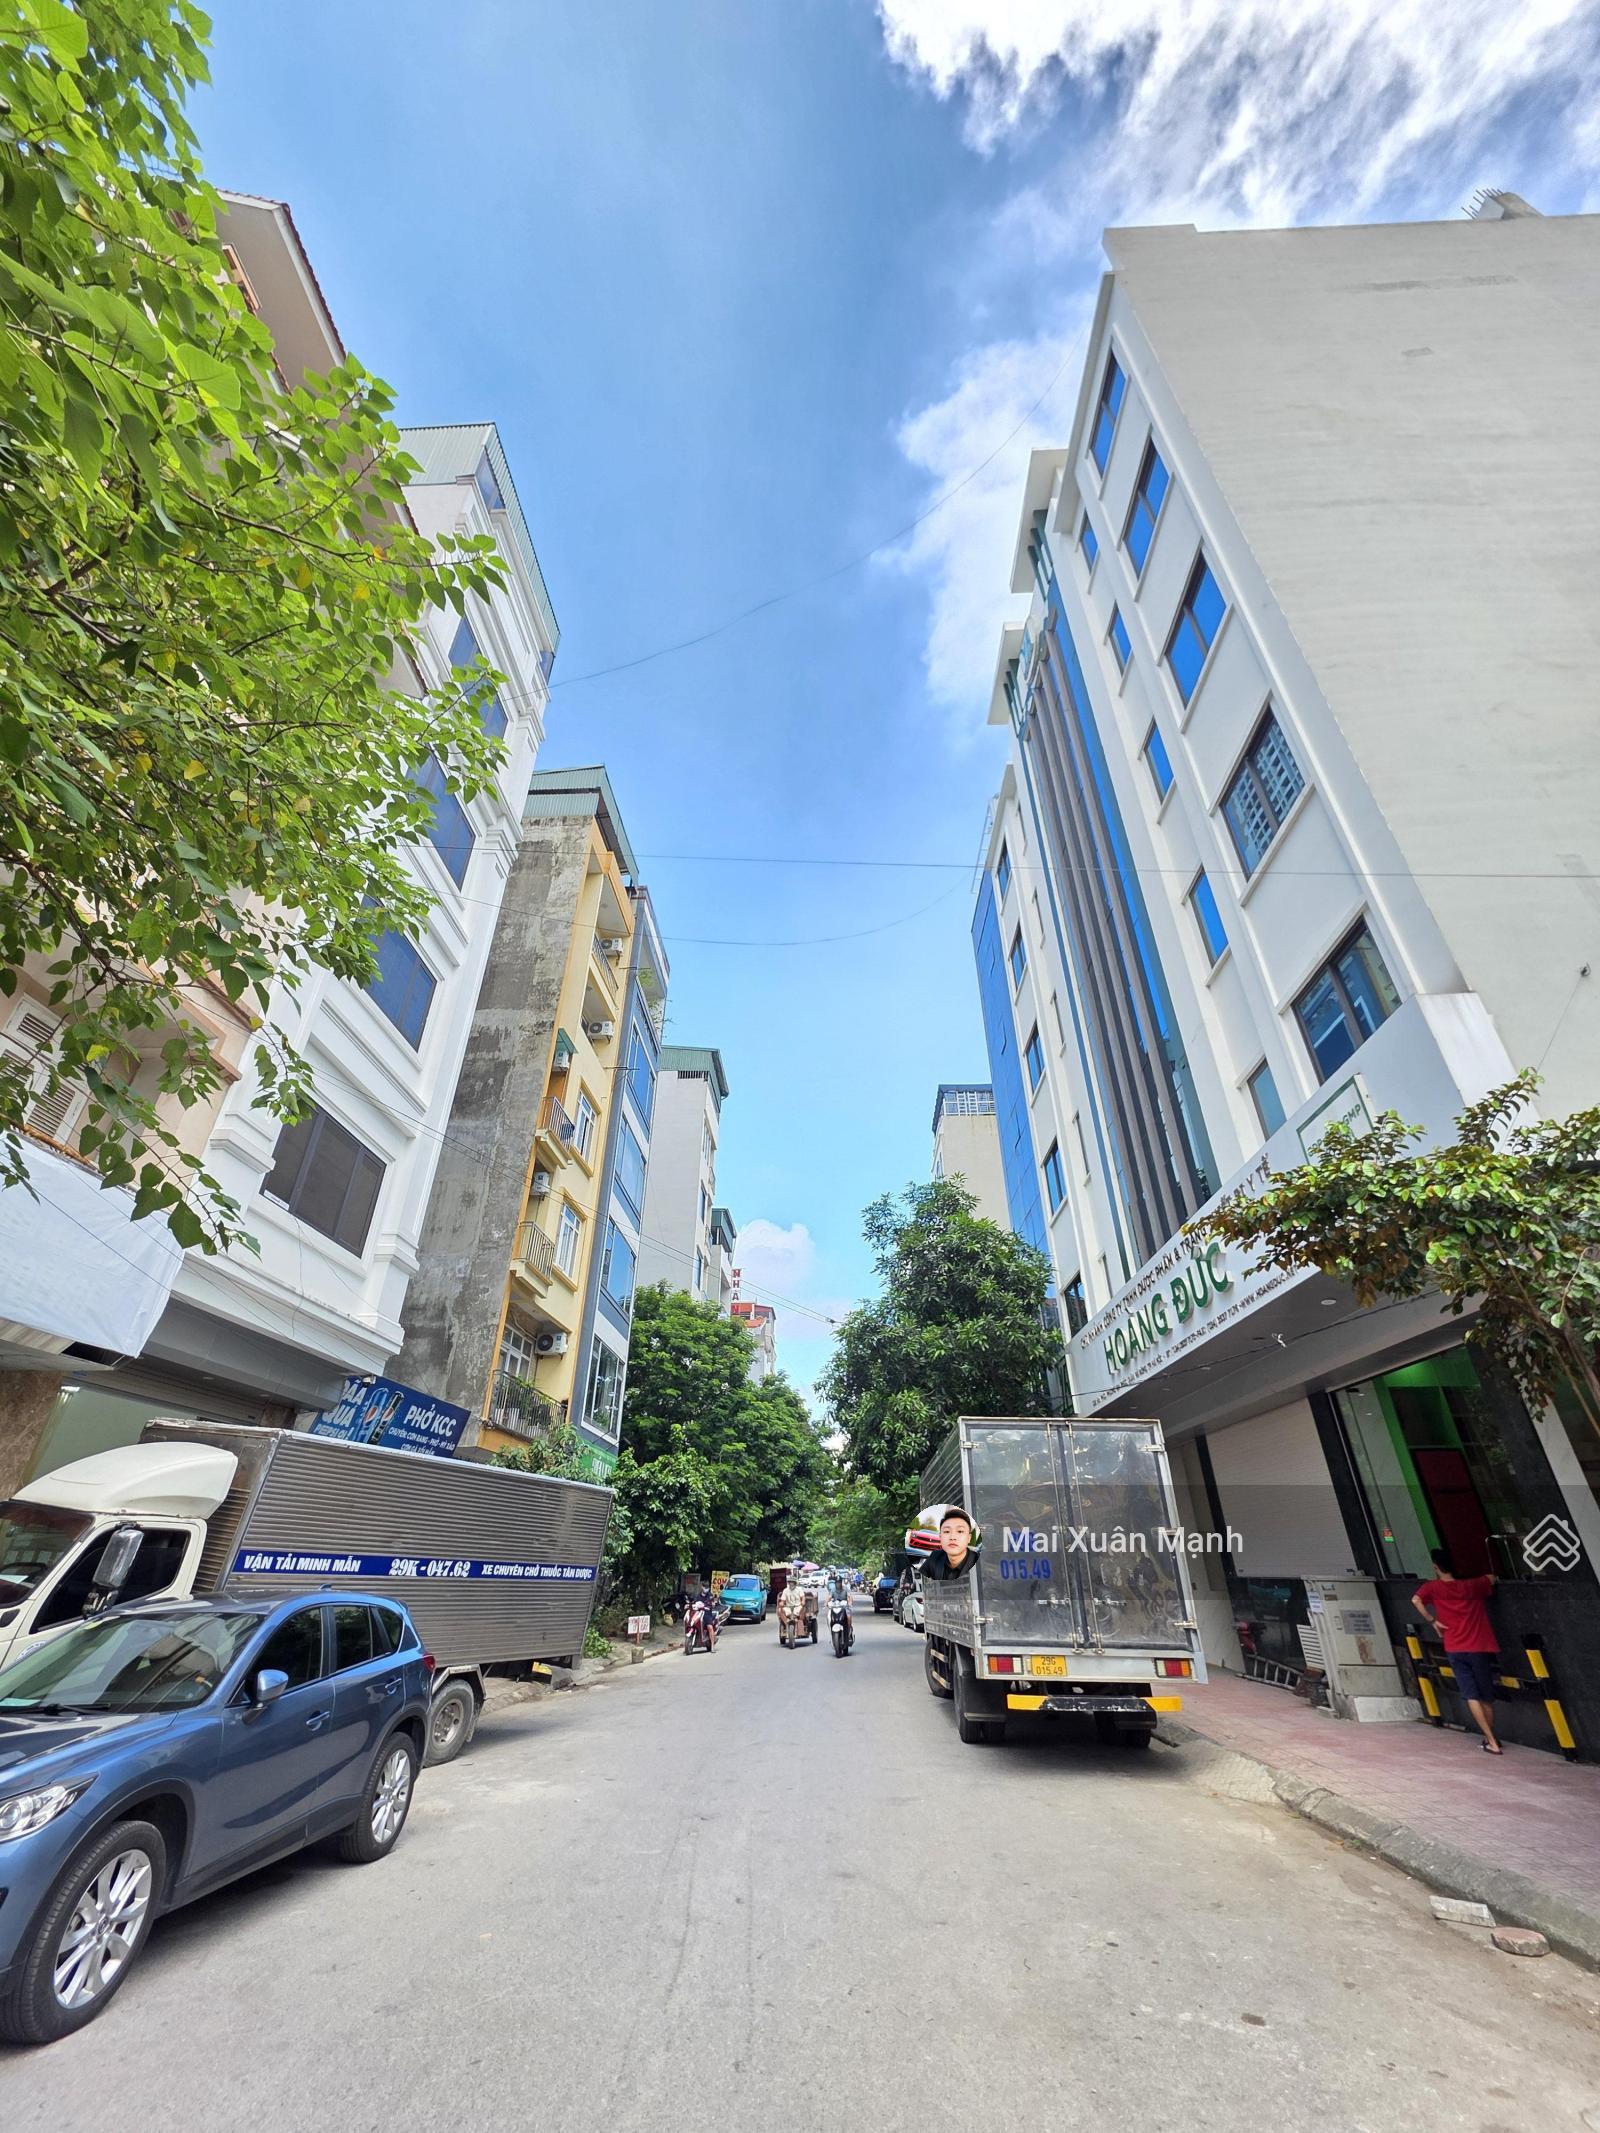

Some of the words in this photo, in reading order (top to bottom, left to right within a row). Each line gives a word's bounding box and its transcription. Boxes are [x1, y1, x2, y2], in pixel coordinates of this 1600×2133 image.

[1174, 1247, 1182, 1261] &
[1103, 1293, 1171, 1376] HOÀNG
[1170, 1241, 1232, 1324] ĐỨC
[403, 1403, 436, 1430] PHỞ
[430, 1414, 457, 1437] KCC
[243, 1553, 273, 1572] VẬN
[275, 1553, 295, 1571] TẢI
[296, 1557, 330, 1571] MINH
[332, 1555, 361, 1572] MẪN
[482, 1564, 493, 1575] XE
[493, 1563, 524, 1577] CHUYÊN
[524, 1563, 540, 1577] CHỞ
[540, 1564, 562, 1578] THUỐC
[562, 1566, 575, 1578] TÂN
[575, 1567, 593, 1580] DƯỢC
[1000, 1558, 1051, 1580] 015.49
[1040, 1656, 1056, 1665] 29G
